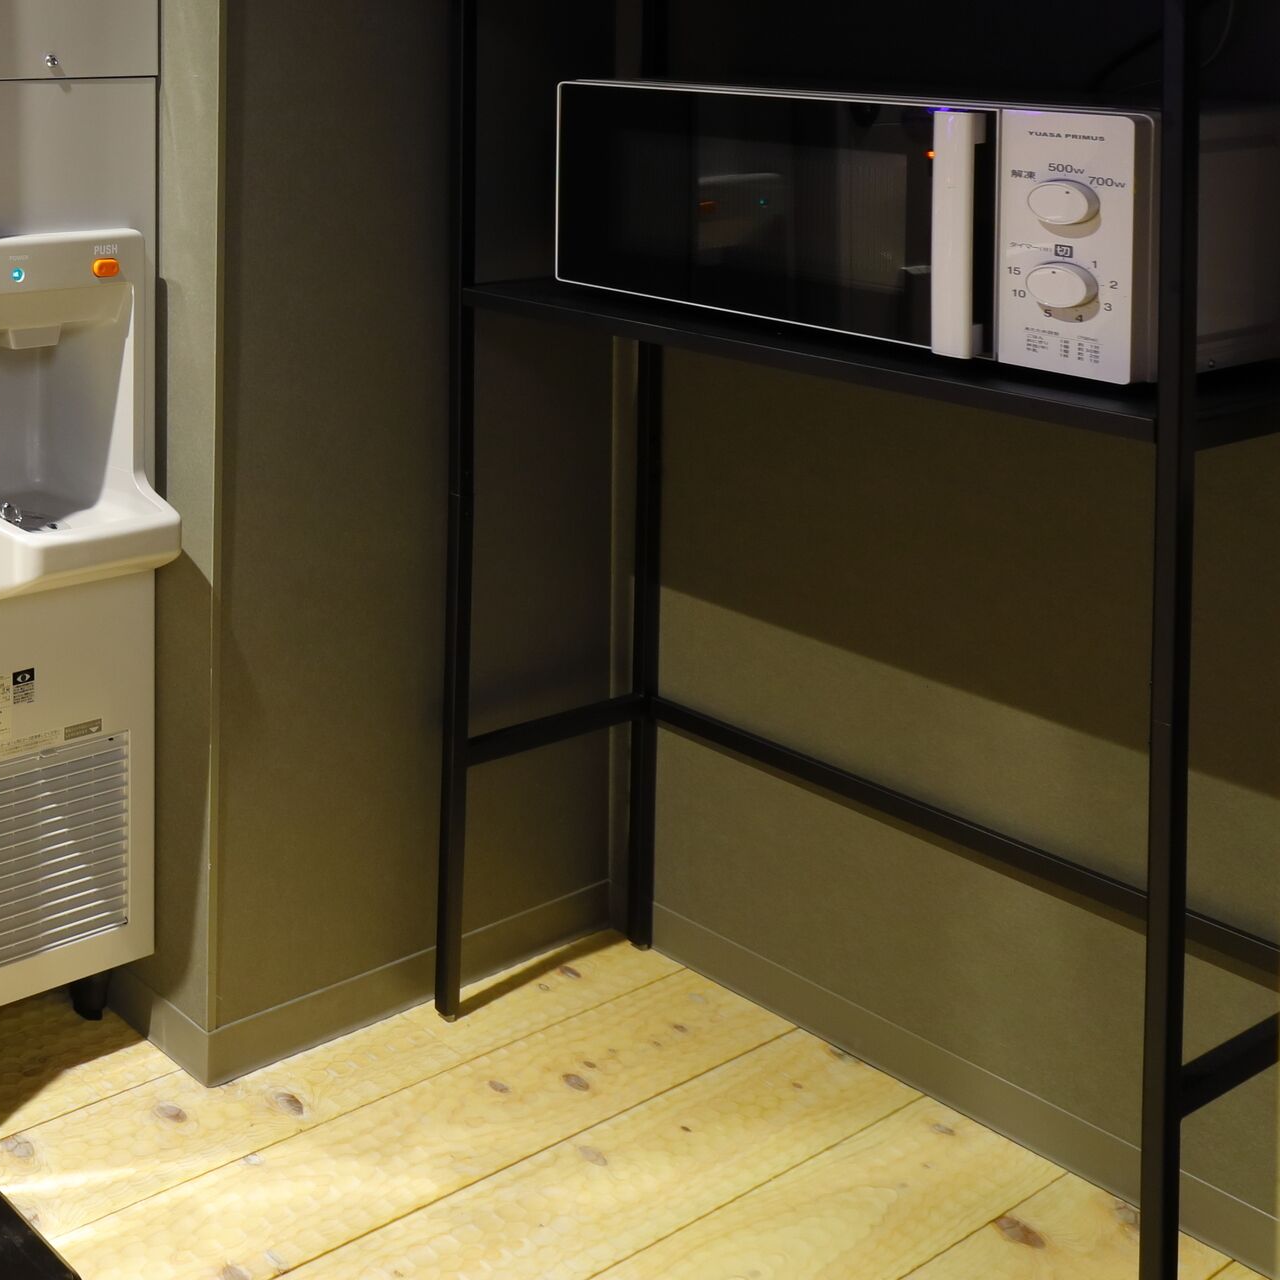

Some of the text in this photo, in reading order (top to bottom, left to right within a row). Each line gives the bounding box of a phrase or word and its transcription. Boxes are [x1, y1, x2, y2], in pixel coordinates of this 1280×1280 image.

[1028, 131, 1062, 139] YUASA
[1011, 170, 1036, 180] 解凍
[94, 244, 117, 254] PUSH
[1008, 266, 1021, 275] 15
[1109, 281, 1118, 289] 2
[1012, 289, 1026, 298] 10
[1104, 303, 1112, 311] 3
[1075, 314, 1083, 322] 4
